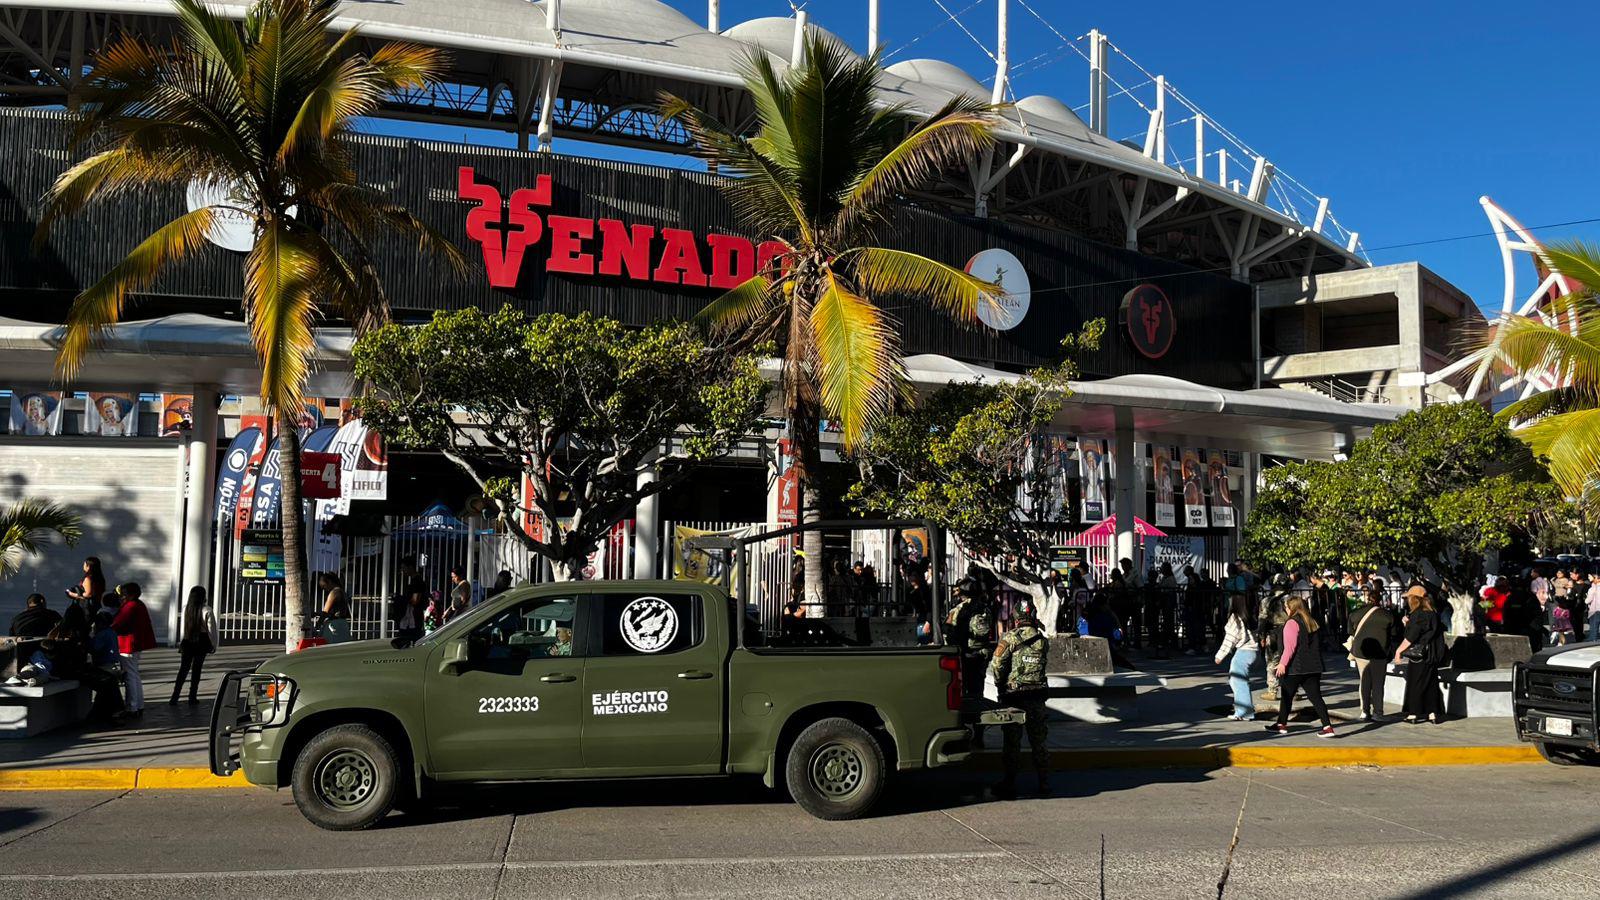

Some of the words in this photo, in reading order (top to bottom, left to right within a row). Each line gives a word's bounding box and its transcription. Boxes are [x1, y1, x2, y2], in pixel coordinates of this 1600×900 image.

[458, 167, 796, 289] VENADO
[322, 463, 337, 489] 4
[1160, 545, 1191, 555] ZONAS
[478, 696, 539, 713] 2323333
[592, 689, 669, 706] EJÉRCITO
[593, 702, 668, 715] MEXICANO
